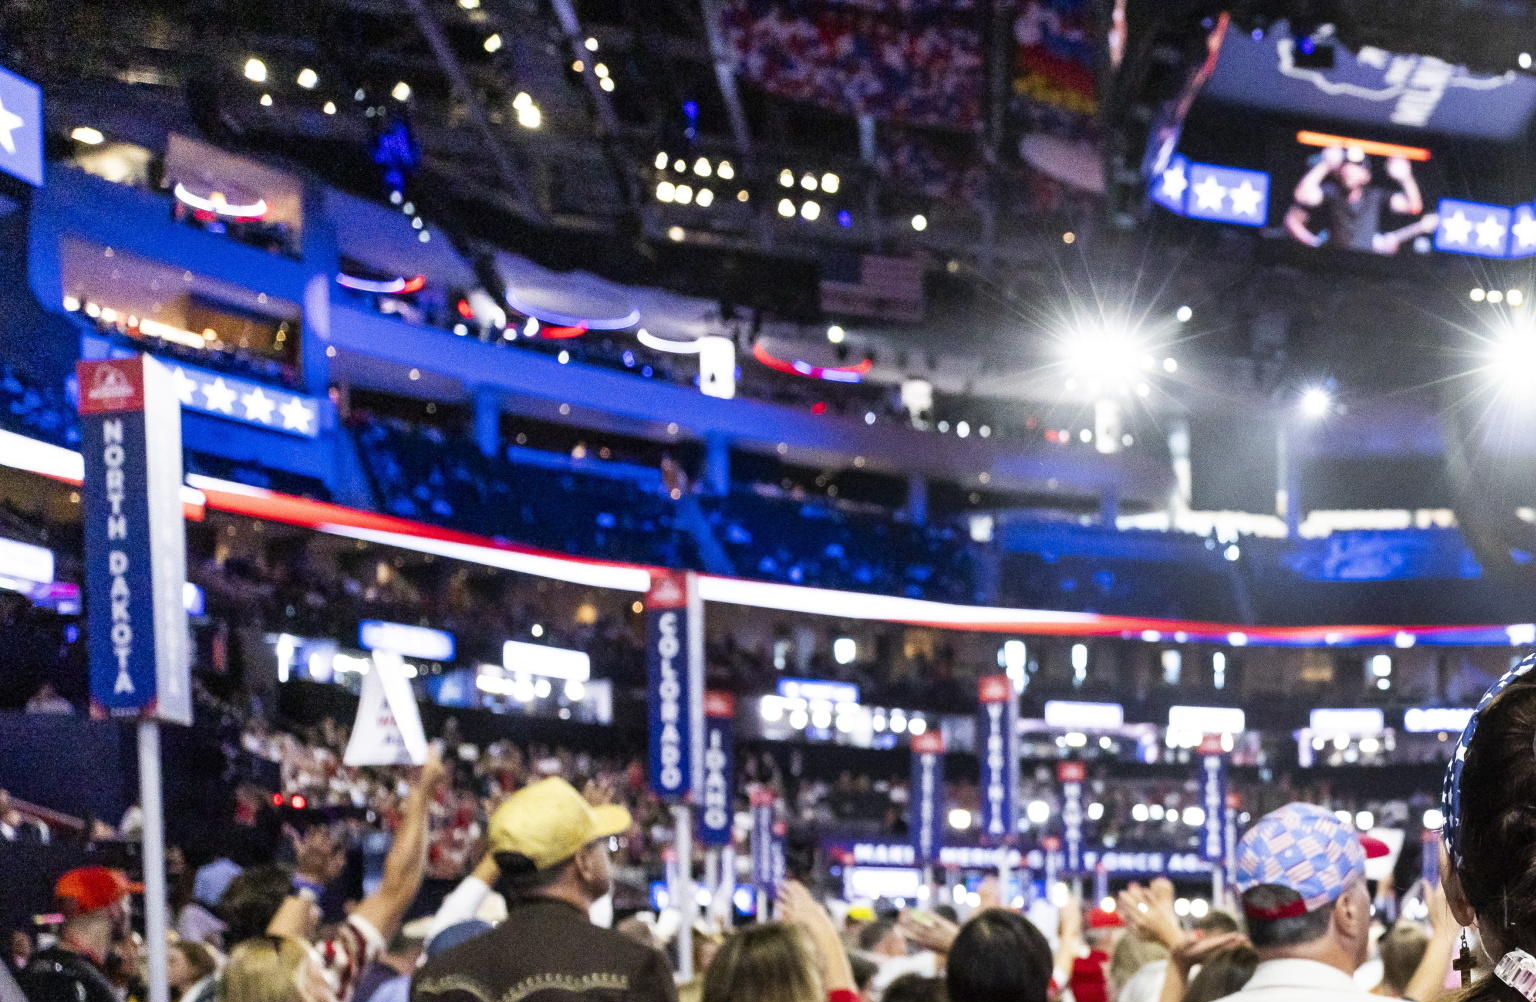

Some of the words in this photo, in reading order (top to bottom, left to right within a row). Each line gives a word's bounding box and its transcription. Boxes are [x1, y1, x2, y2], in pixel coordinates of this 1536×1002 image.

[102, 419, 127, 540] NORTH
[108, 551, 135, 694] DAKOTA
[658, 612, 682, 790] COLORADO
[704, 729, 727, 830] IDAHO
